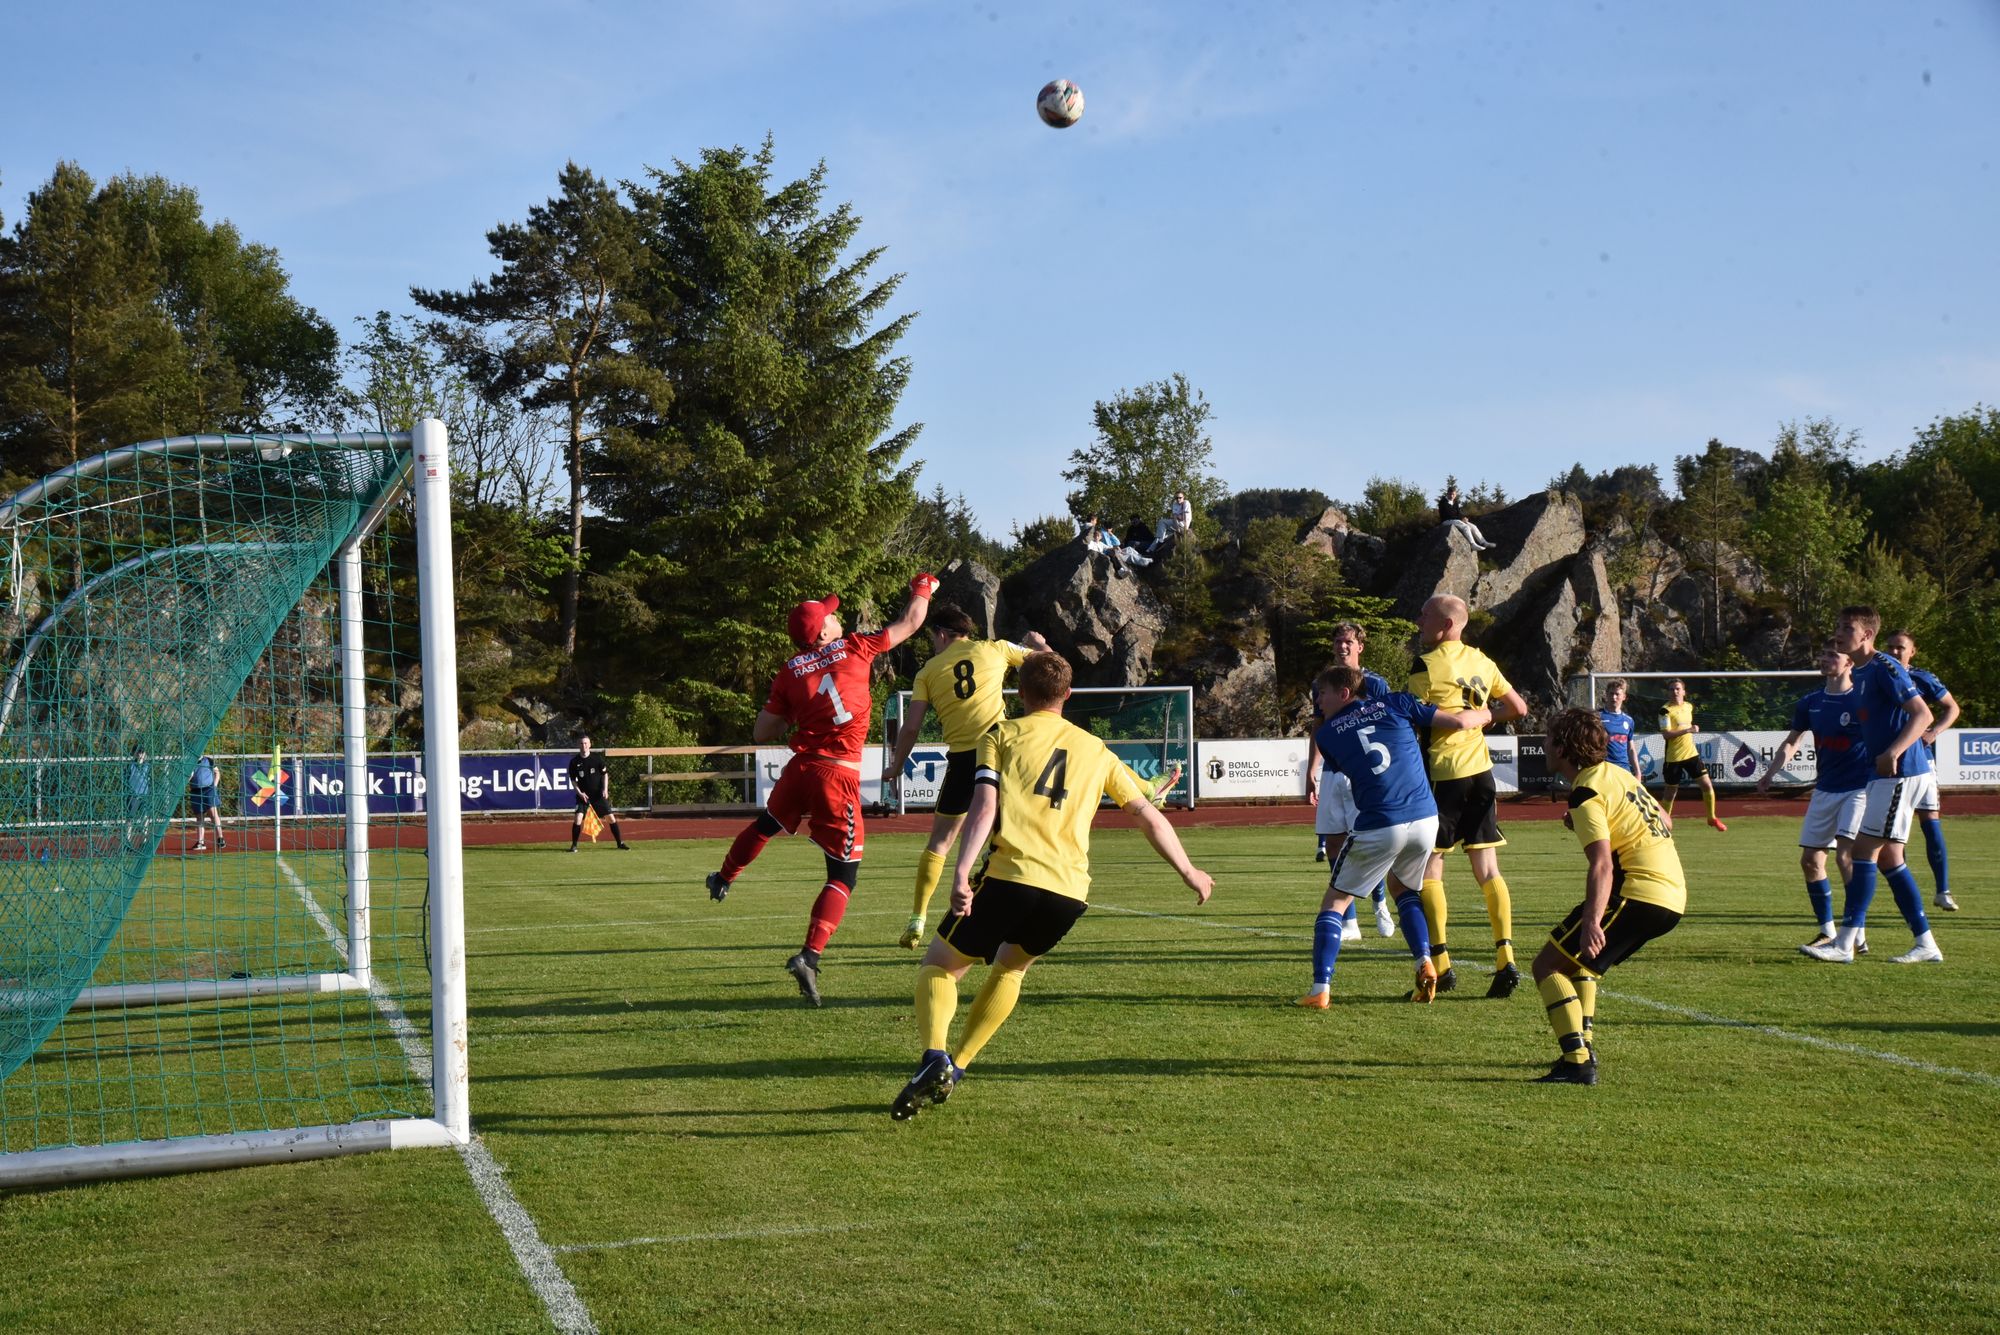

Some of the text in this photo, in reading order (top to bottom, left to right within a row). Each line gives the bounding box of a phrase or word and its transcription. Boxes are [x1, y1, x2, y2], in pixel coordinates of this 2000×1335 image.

[788, 639, 845, 669] REMA 1000
[952, 659, 977, 699] 8
[817, 673, 853, 726] 1
[1228, 761, 1260, 769] BØMLO
[1357, 725, 1392, 775] 5
[1033, 747, 1069, 810] 4
[1228, 769, 1289, 778] BYGGSERVICE
